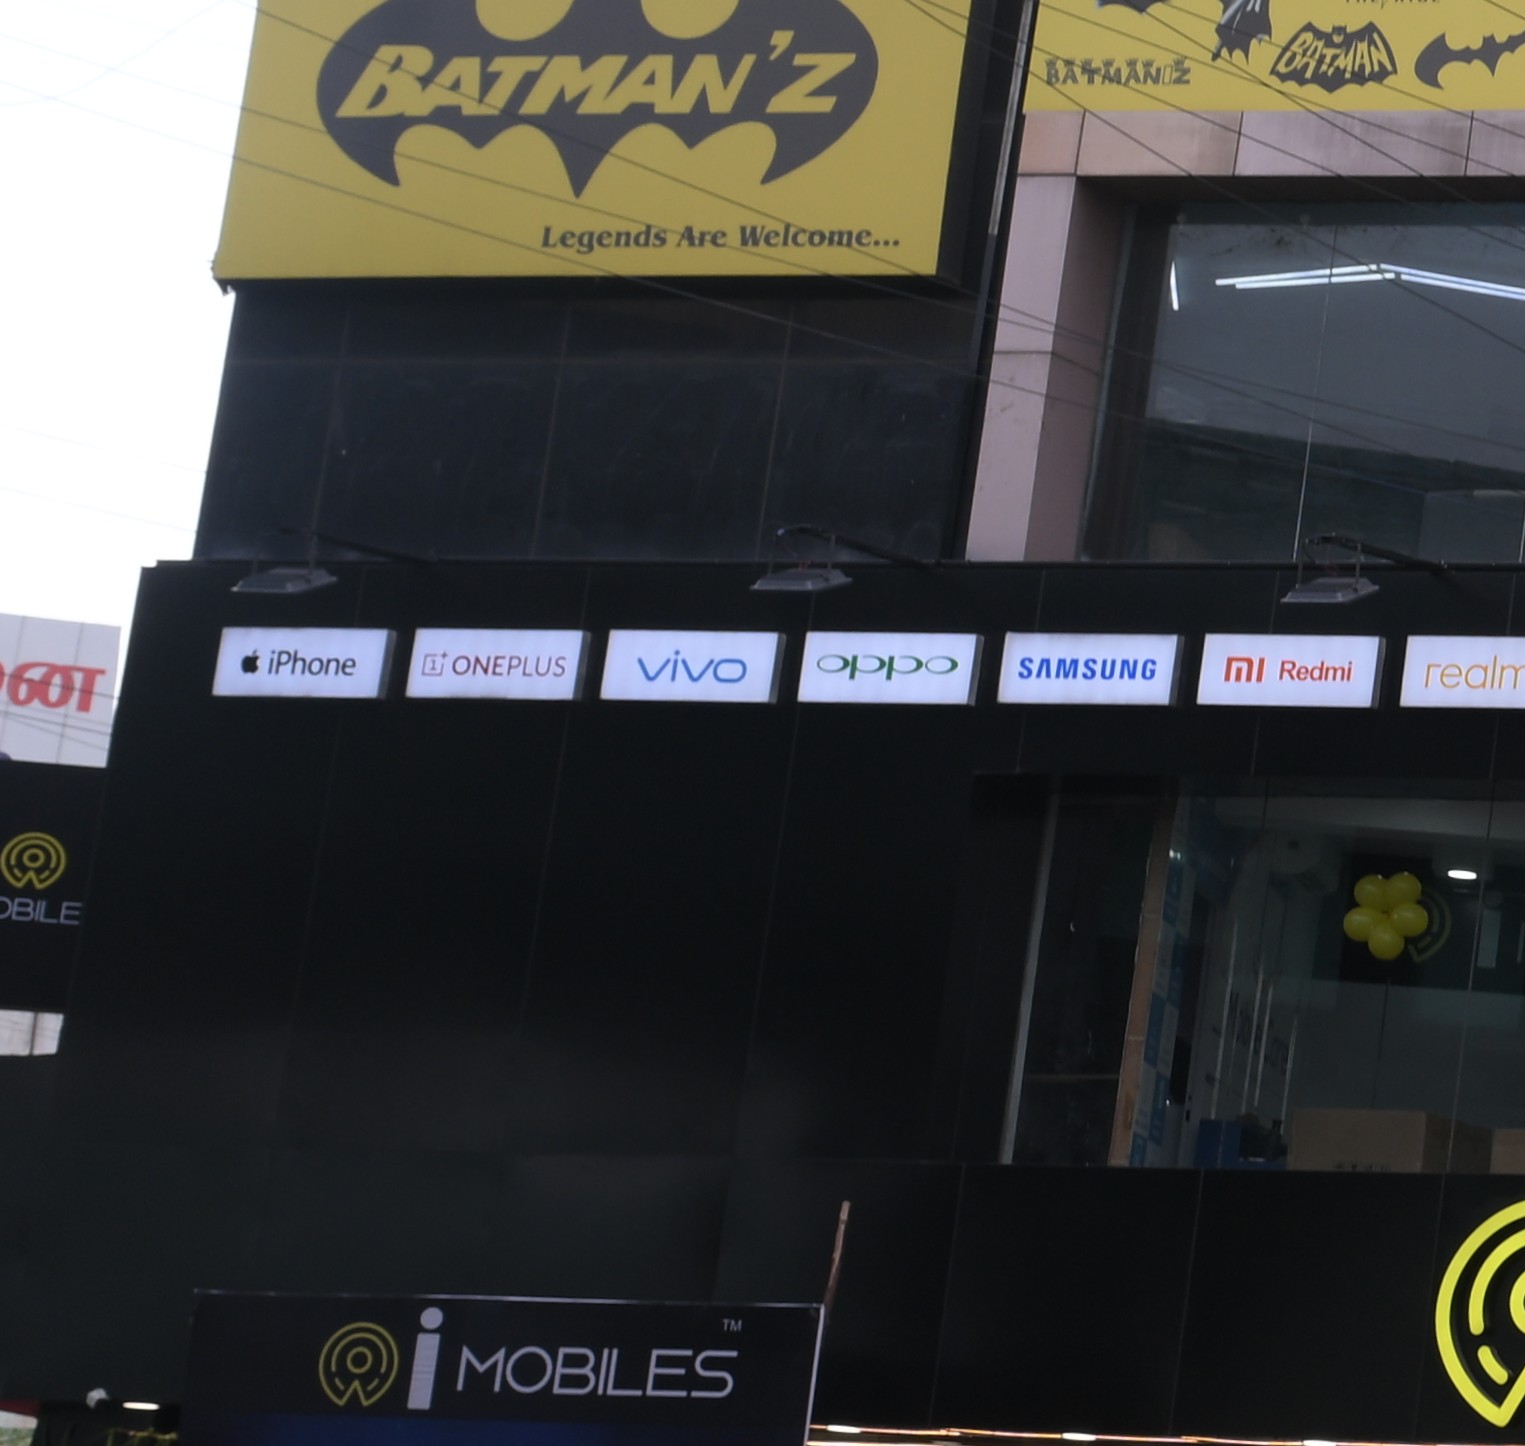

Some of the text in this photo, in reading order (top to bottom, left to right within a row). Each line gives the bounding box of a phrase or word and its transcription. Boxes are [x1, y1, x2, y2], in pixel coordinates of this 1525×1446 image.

[1284, 31, 1388, 82] BATMAN
[336, 30, 858, 119] BATMAN'Z
[541, 223, 900, 255] Legends Are Welcome...
[267, 650, 356, 678] iPhone
[452, 655, 566, 679] ONEPLUS
[637, 649, 748, 683] vivo
[817, 653, 959, 681] oppo
[1018, 656, 1157, 681] SAMSUNG
[1279, 658, 1352, 682] Redmi
[456, 1345, 739, 1399] MOBILES
